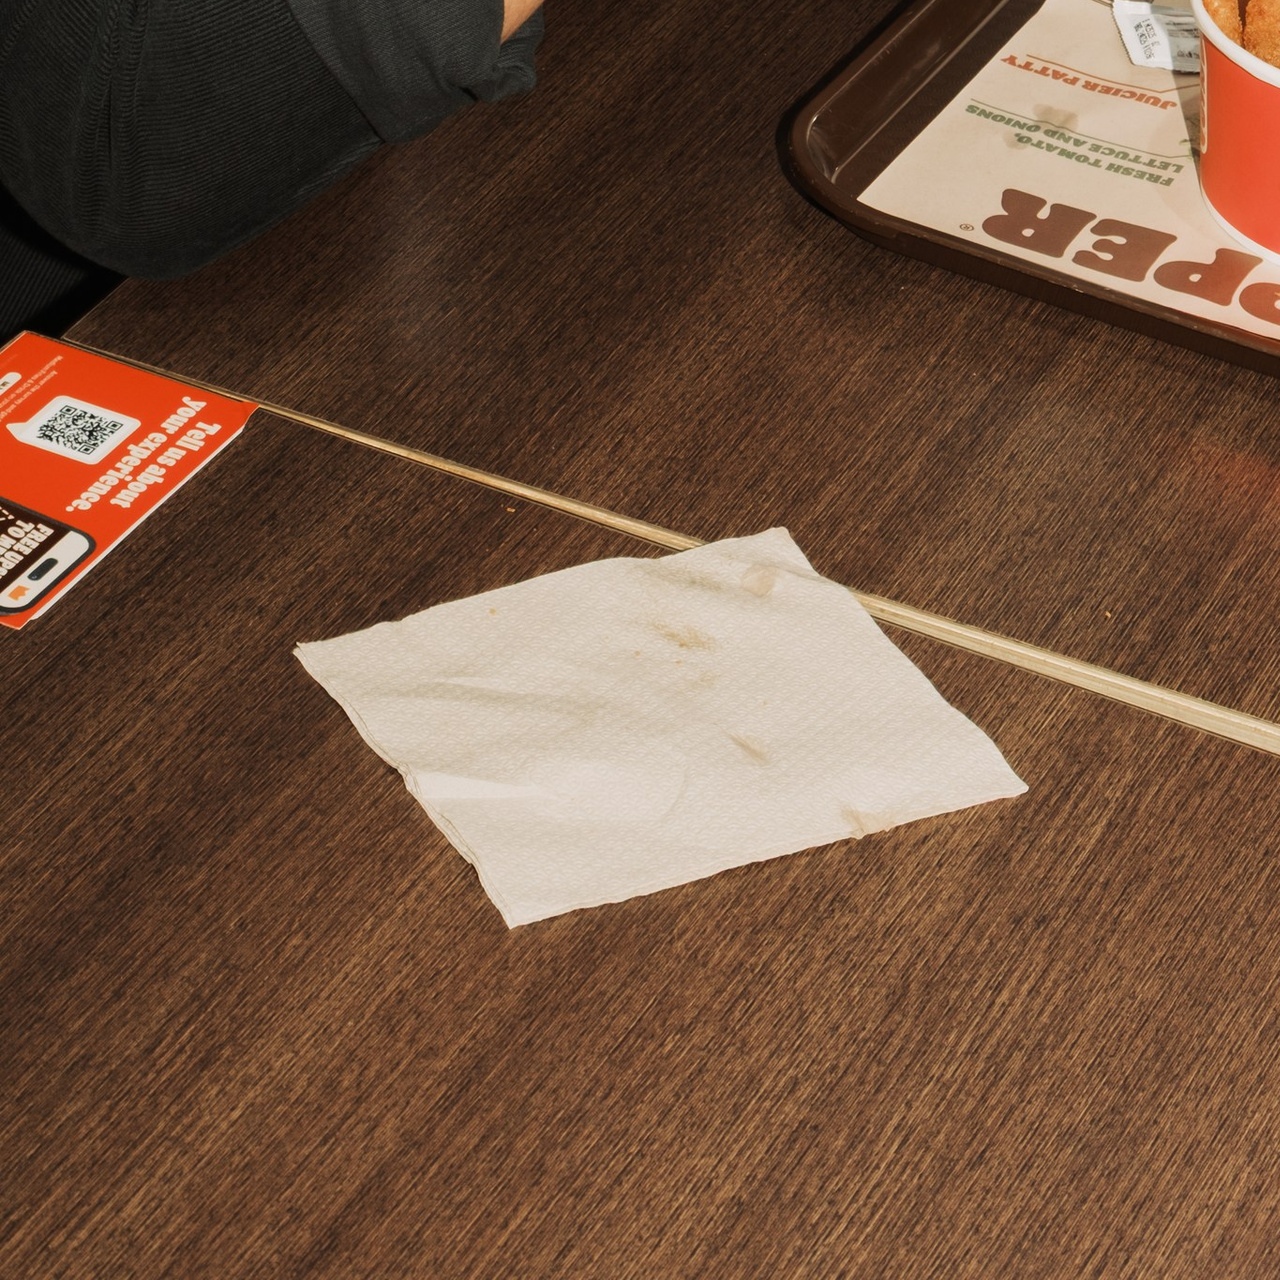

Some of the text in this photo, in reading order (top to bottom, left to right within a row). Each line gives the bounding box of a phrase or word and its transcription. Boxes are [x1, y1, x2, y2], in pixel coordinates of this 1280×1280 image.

[1001, 54, 1178, 110] JUICIER PATTY
[965, 104, 1184, 174] LETTUCE AND ONIONS
[1014, 132, 1175, 187] FRESH TOMATO,
[65, 396, 207, 512] your experience.
[109, 421, 222, 509] Tell us about
[7, 520, 36, 539] TO
[12, 523, 55, 556] FREE
